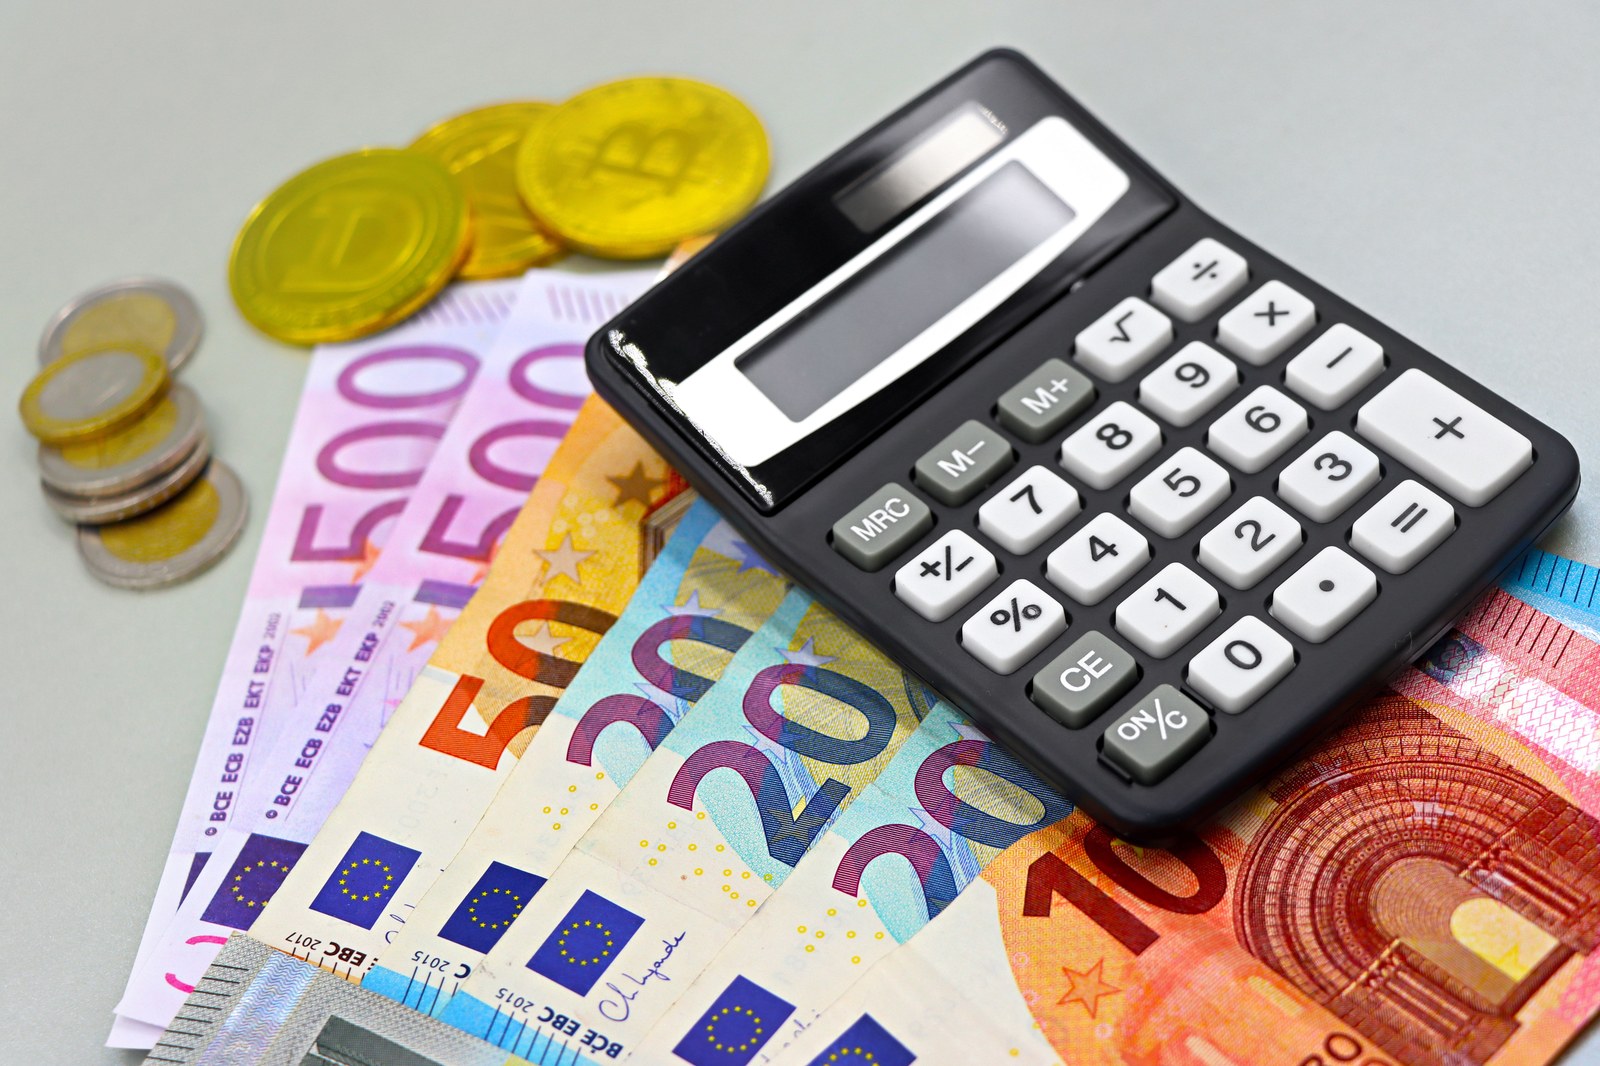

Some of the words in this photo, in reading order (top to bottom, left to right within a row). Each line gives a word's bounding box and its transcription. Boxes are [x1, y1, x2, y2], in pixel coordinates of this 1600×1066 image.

[1174, 362, 1211, 389] 9
[1020, 377, 1069, 415] M+
[1244, 405, 1282, 434] 6
[1095, 422, 1133, 451] 8
[290, 345, 481, 562] 500
[1313, 452, 1353, 482] 3
[1162, 467, 1202, 498] 5
[1010, 484, 1044, 516] 7
[850, 497, 911, 542] MRC
[1088, 535, 1119, 562] 4
[1234, 519, 1277, 553] 2
[989, 596, 1043, 633] %
[1154, 587, 1187, 611] 1
[1059, 648, 1114, 693] CE
[1223, 639, 1263, 671] 0
[243, 680, 265, 709] EKT
[418, 598, 619, 771] 50
[232, 717, 254, 746] EZB
[273, 774, 303, 807] BCE
[294, 738, 323, 769] ECB
[315, 703, 342, 733] EZB
[336, 666, 362, 696] EKT
[354, 632, 380, 662] EKP
[1116, 698, 1189, 742] ON/C
[221, 752, 244, 783] ECB
[667, 662, 897, 868] 20
[209, 791, 233, 821] BCE
[831, 739, 1075, 921] 20
[1022, 823, 1227, 957] 10
[285, 931, 322, 951] 2017
[323, 941, 367, 967] EBC
[411, 950, 450, 972] 2015
[495, 987, 535, 1014] 2015
[537, 1006, 581, 1037] EBC
